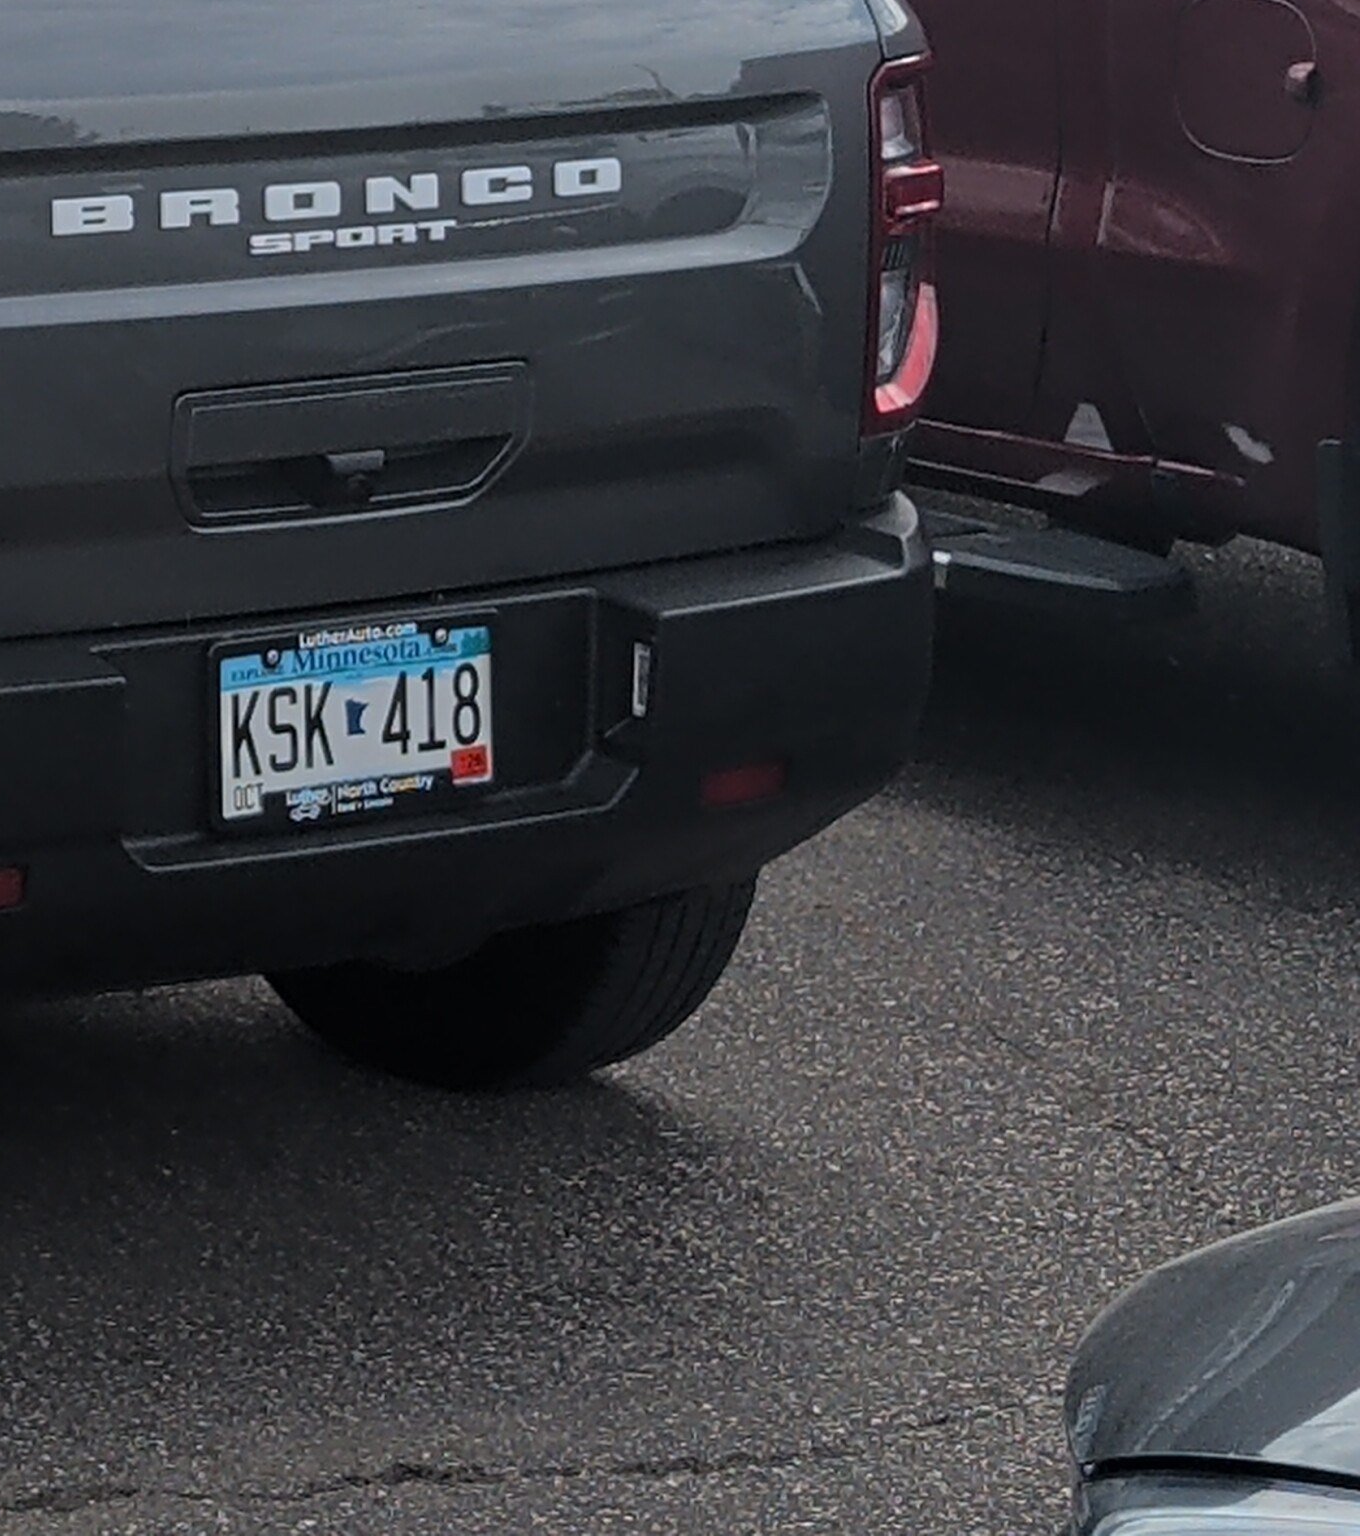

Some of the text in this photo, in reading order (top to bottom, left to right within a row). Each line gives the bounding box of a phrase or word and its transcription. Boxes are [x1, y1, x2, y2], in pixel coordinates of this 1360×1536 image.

[51, 157, 622, 236] BRONCO
[249, 220, 458, 256] SPORT
[298, 622, 417, 649] LutherAuto.com
[292, 641, 421, 673] Minnesota
[231, 662, 481, 778] KSK 418
[337, 781, 377, 800] North
